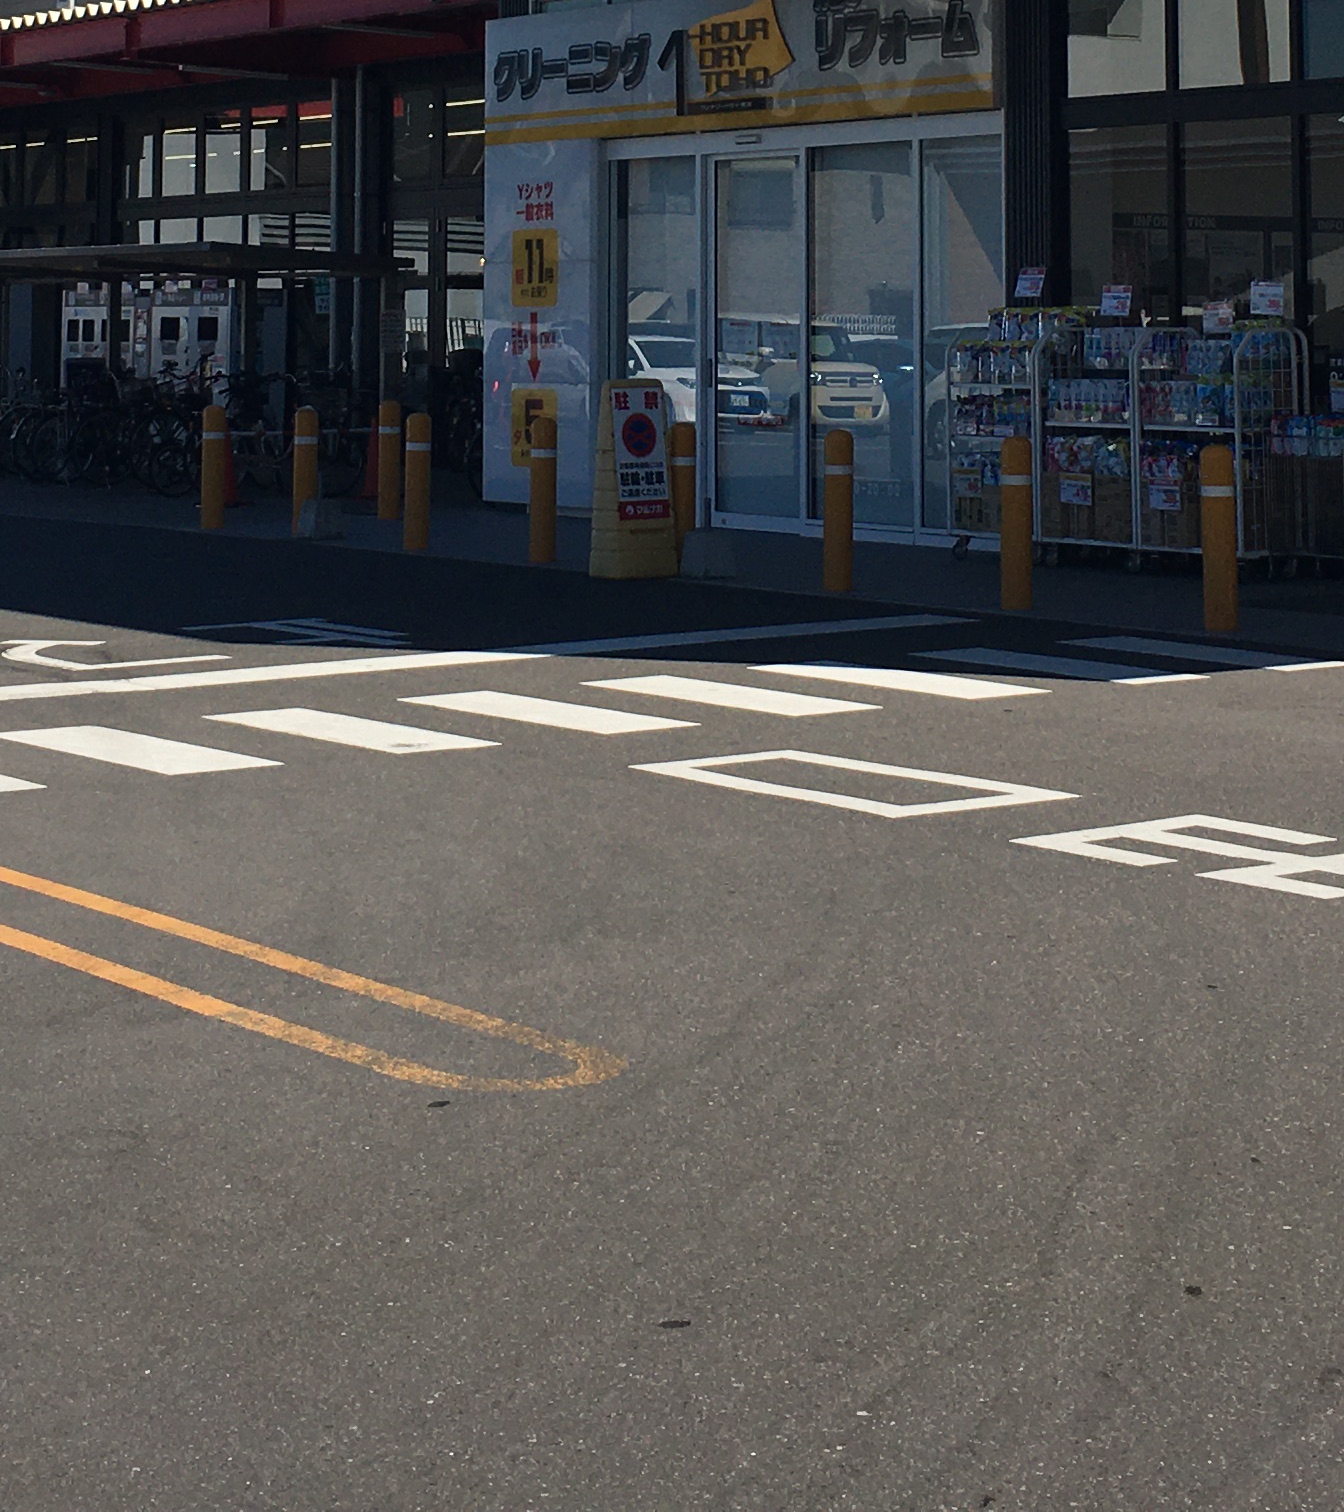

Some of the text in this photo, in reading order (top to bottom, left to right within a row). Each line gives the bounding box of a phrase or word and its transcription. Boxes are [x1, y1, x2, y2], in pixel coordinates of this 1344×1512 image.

[699, 18, 770, 45] HOUR
[493, 33, 651, 102] クリーニング
[699, 43, 752, 70] DRY
[517, 181, 554, 200] Yシャツ
[1133, 215, 1217, 228] INFORTION
